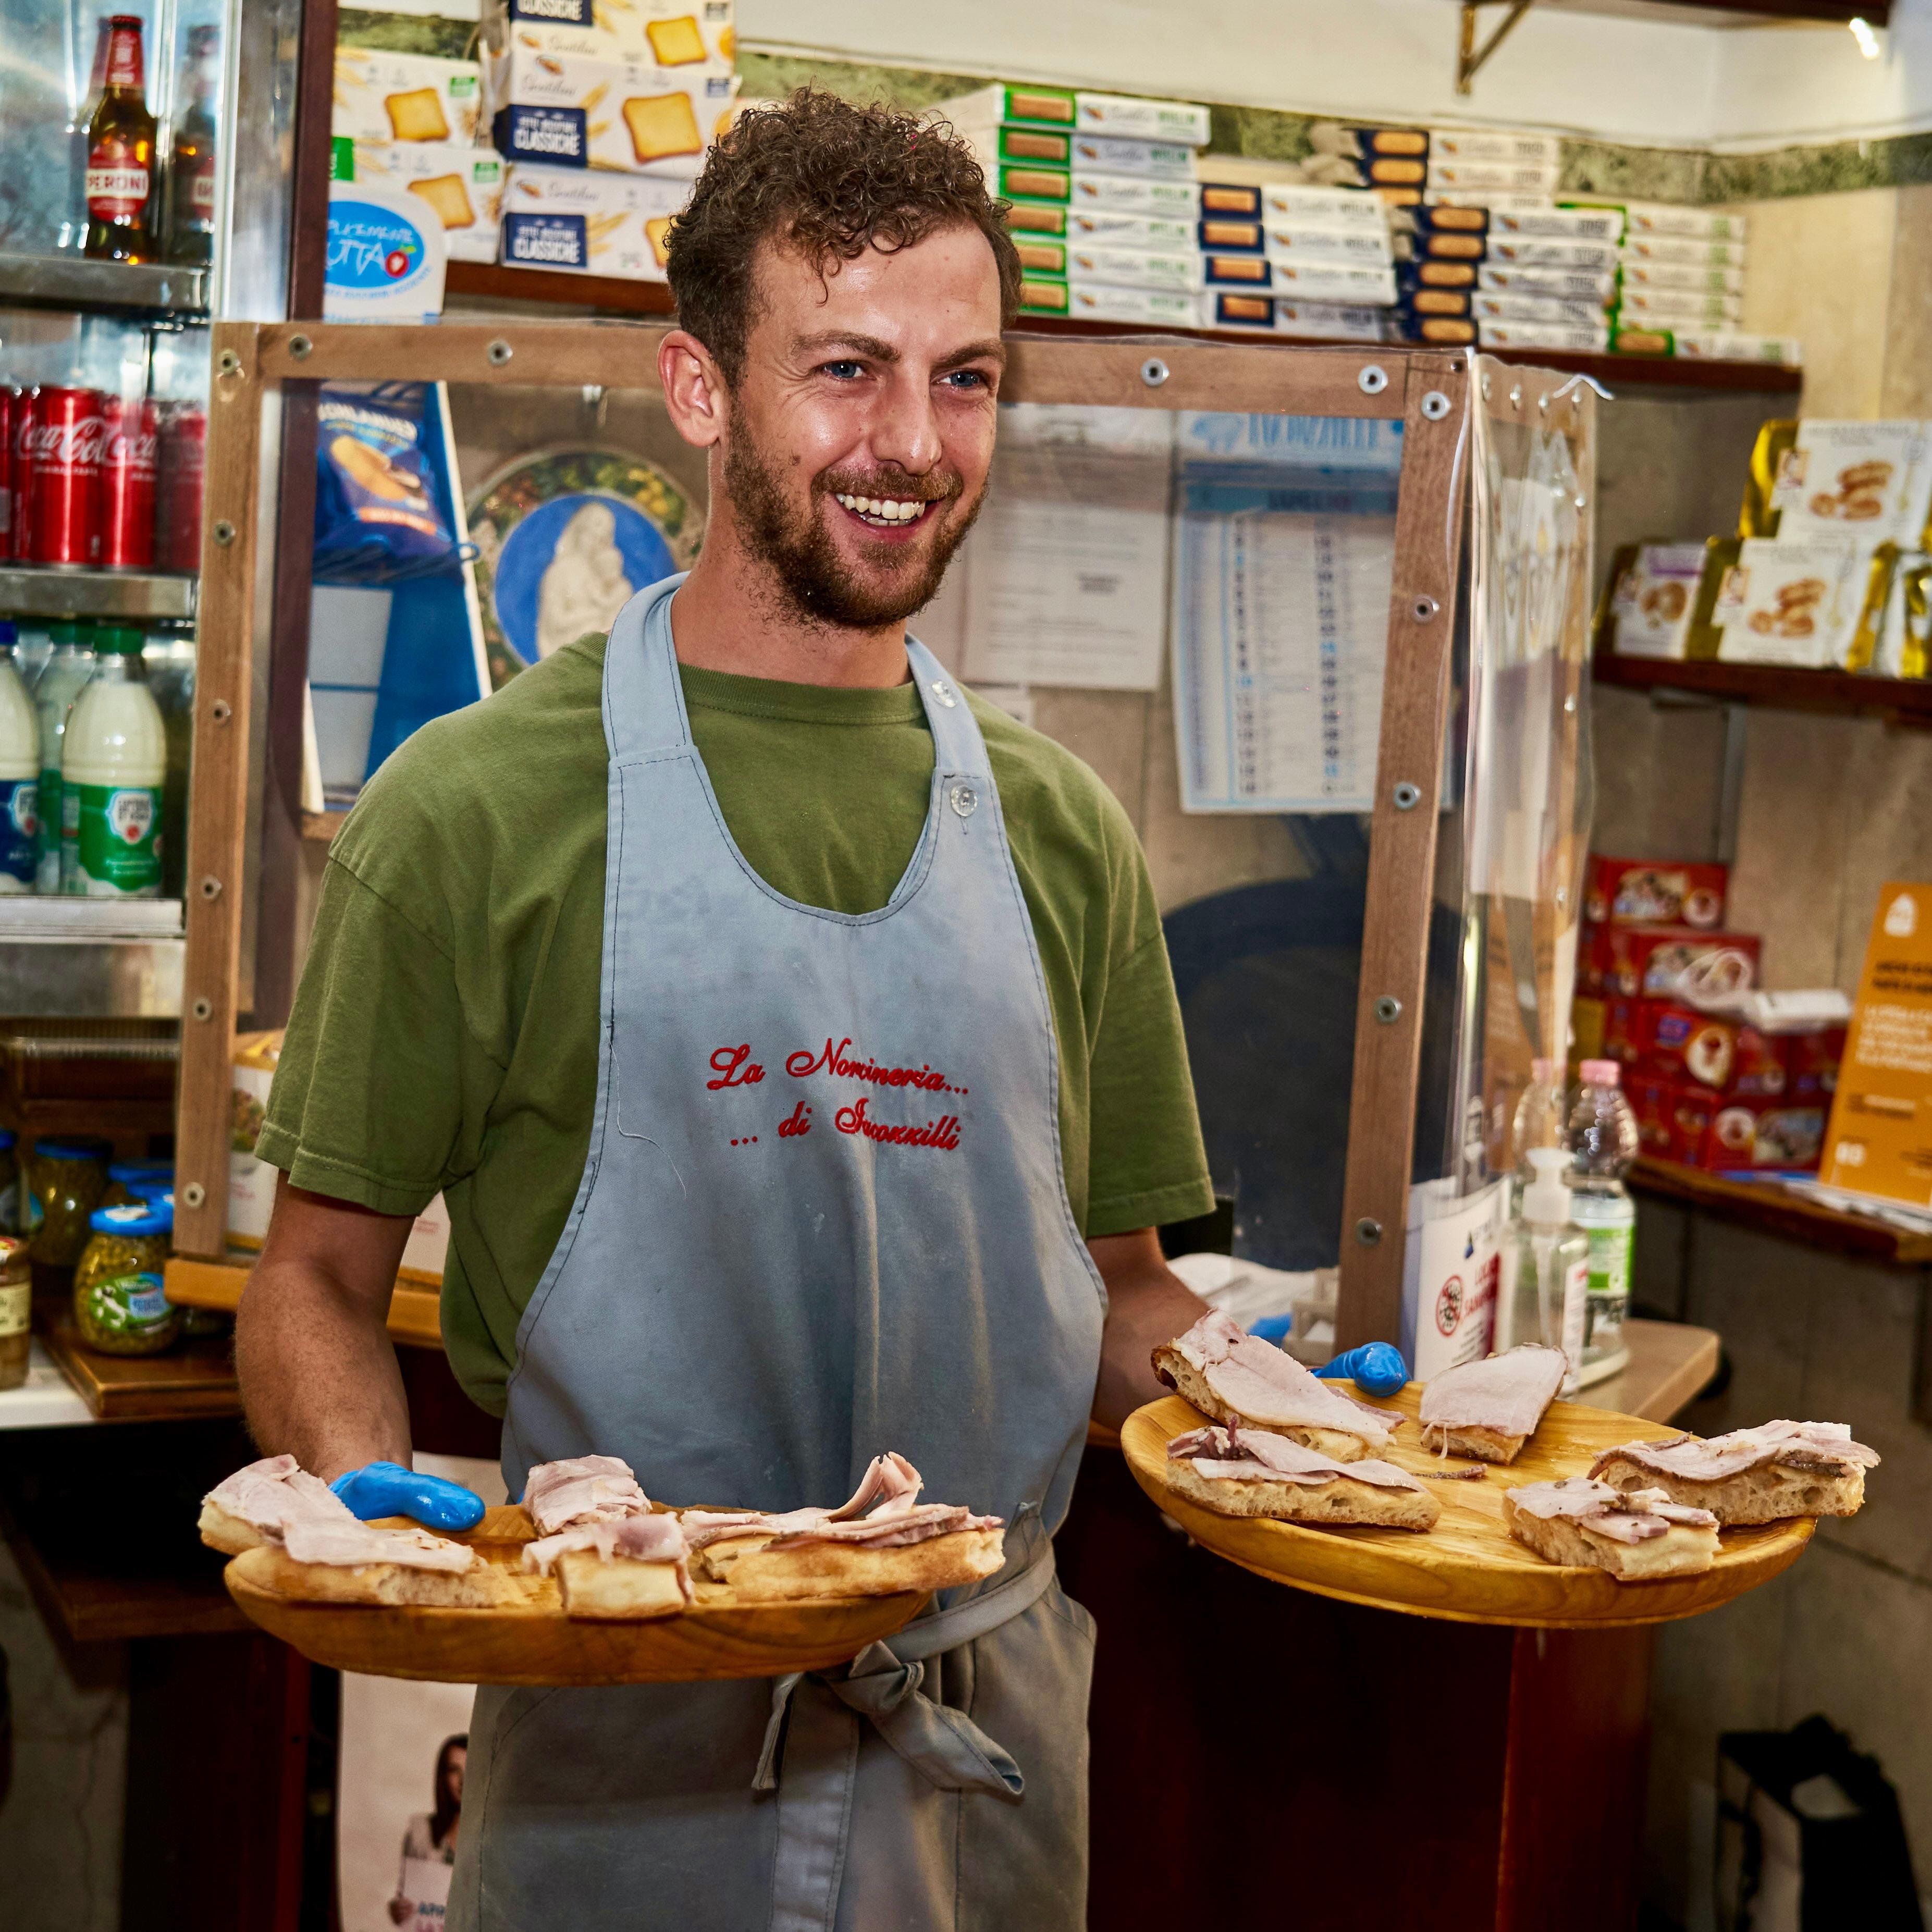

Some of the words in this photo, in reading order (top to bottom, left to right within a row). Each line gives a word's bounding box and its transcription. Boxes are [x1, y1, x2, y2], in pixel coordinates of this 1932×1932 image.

[513, 128, 581, 156] CLASSICHE
[87, 175, 146, 191] PERONI
[513, 237, 581, 264] CLASSICHE
[707, 1043, 766, 1090] La
[778, 1101, 813, 1138] di
